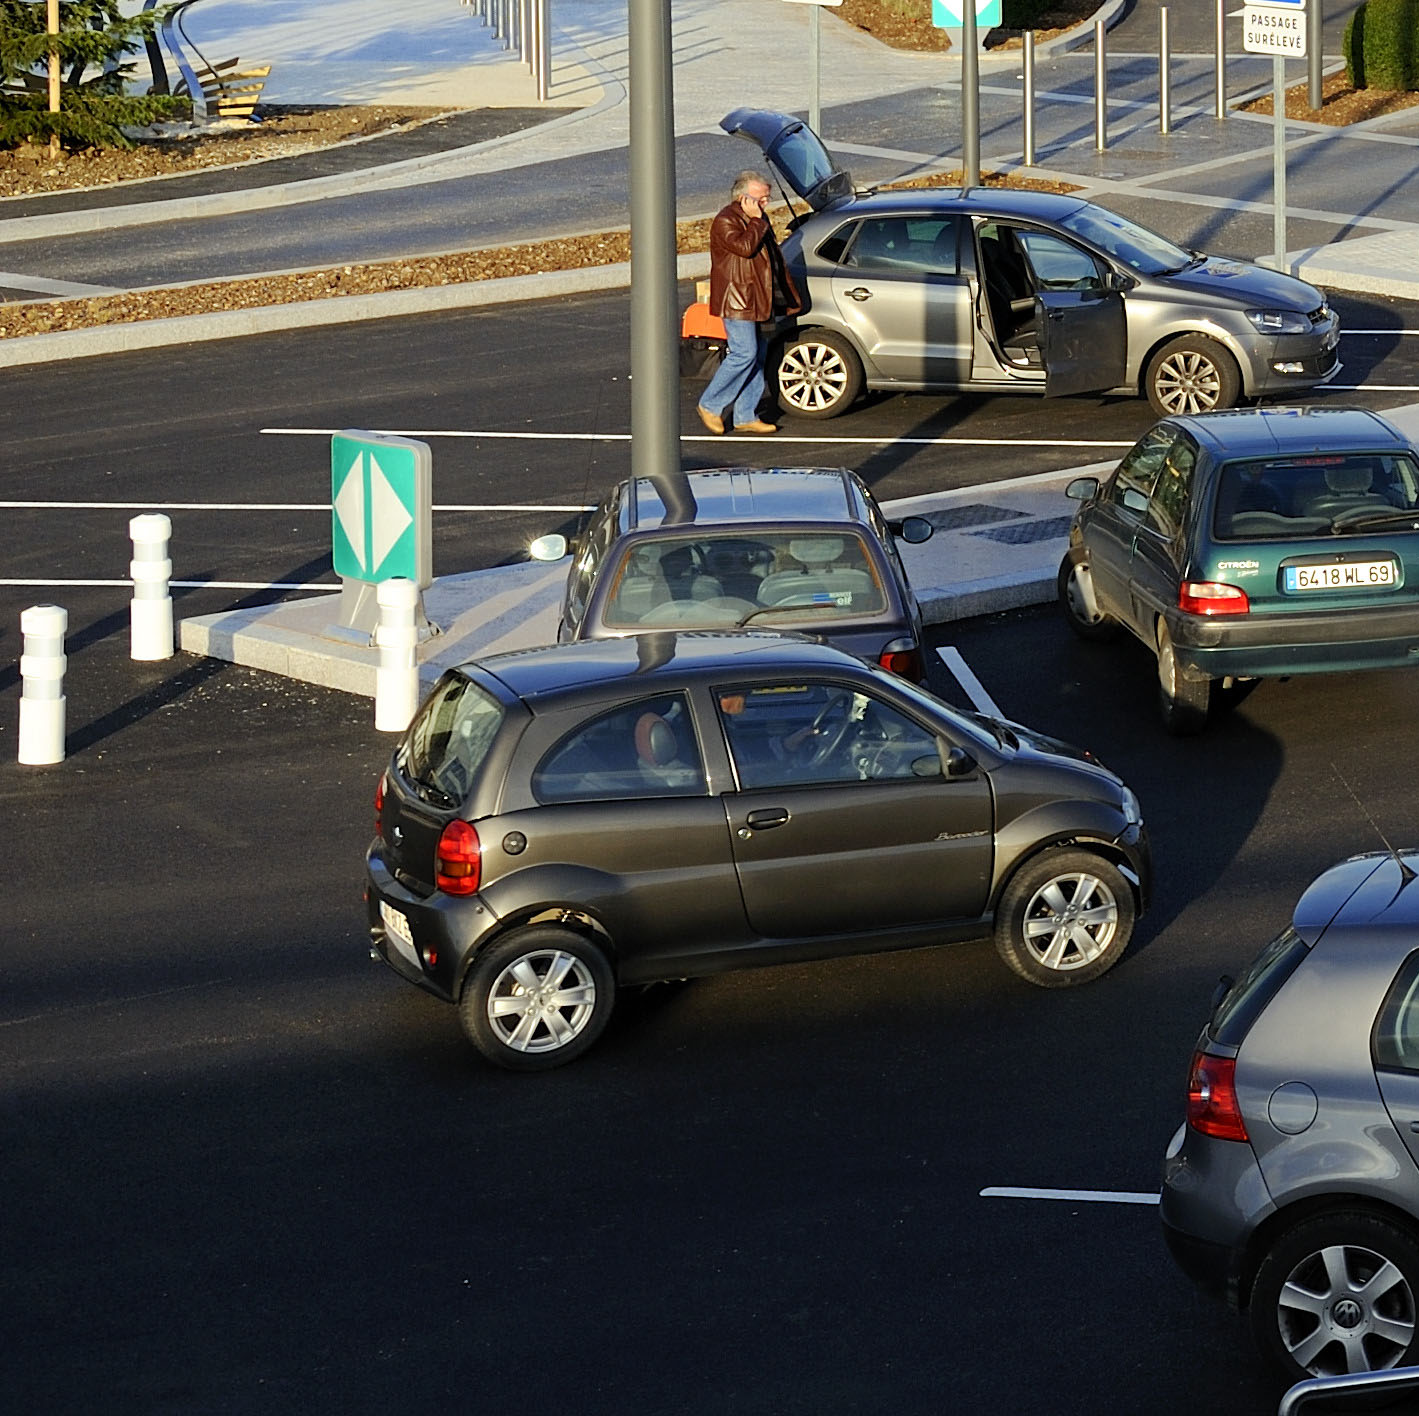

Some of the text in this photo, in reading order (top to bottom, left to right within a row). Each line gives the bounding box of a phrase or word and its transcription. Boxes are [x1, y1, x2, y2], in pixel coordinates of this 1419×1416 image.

[1251, 14, 1298, 30] PASSAGE
[1248, 32, 1302, 49] SURÉLEVÉ
[1217, 559, 1260, 570] CITROËN
[1299, 565, 1389, 587] 6418 WL 69
